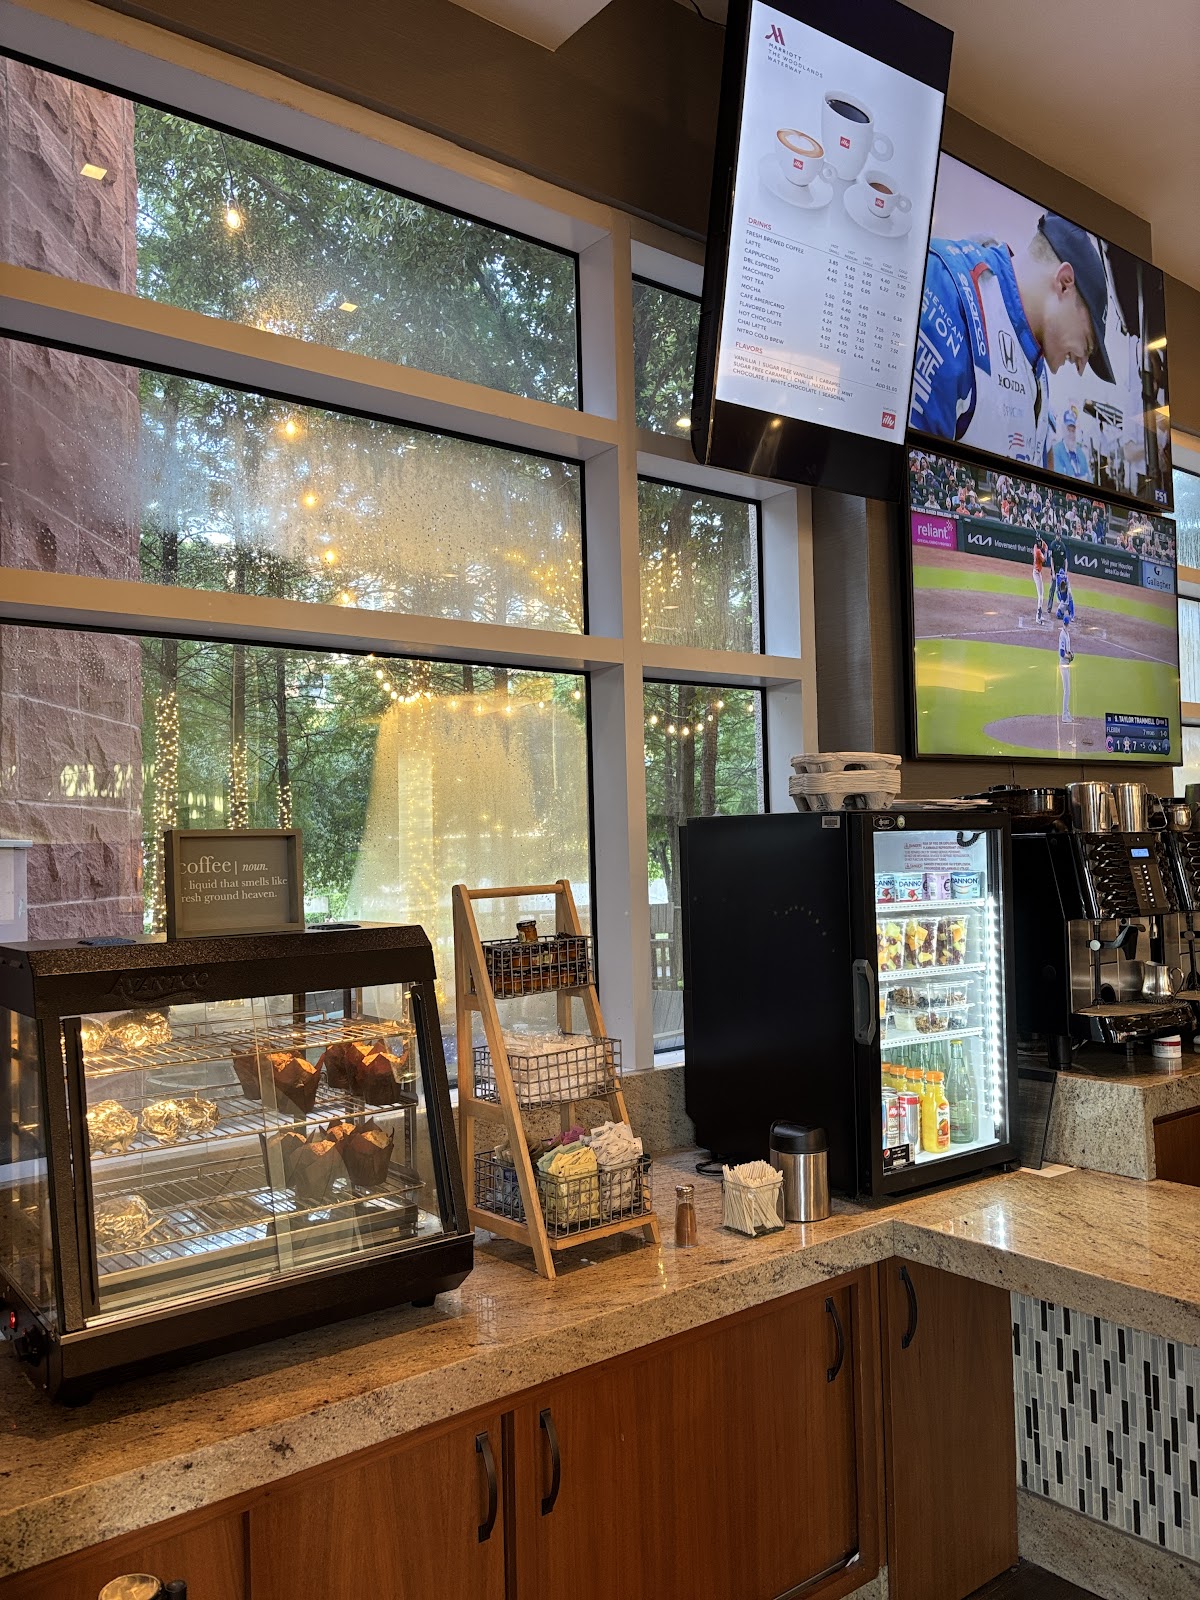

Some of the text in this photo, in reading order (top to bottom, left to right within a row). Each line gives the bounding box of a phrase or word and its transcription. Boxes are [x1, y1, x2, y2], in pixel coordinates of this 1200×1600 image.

[768, 43, 802, 61] MARRIOTT
[768, 49, 823, 78] THE WOODLANDS
[768, 56, 802, 74] WATERWAY
[748, 217, 772, 231] DRINKS
[745, 238, 761, 249] LATTE
[746, 229, 762, 240] FRESH
[763, 235, 785, 248] BREWED
[786, 243, 804, 255] COFFEE
[744, 247, 779, 264] CAPPUCCINO
[743, 265, 774, 280] MACCHIATO
[755, 260, 781, 274] ESPRESSO
[742, 274, 754, 283] HOT
[754, 278, 765, 286] TEA
[741, 283, 761, 294] MOCHA
[739, 300, 766, 313] FLAVORED
[766, 309, 782, 318] LATTE
[754, 296, 785, 310] AMERICANO
[738, 309, 750, 318] HOT
[751, 313, 782, 327] CHOCOLATE
[925, 288, 964, 342] MERICAN
[738, 318, 751, 326] CHAI
[751, 322, 767, 331] LATTE
[737, 326, 753, 336] NITRO
[754, 332, 769, 341] COLD
[770, 336, 784, 345] BREW
[736, 341, 763, 354] FLAVORS
[762, 362, 779, 371] SUGAR
[780, 367, 792, 375] FREE
[734, 360, 751, 370] SUGAR
[752, 366, 764, 374] FREE
[765, 369, 789, 380] CARAMEL
[794, 377, 807, 385] CHAI
[811, 382, 836, 394] HAZELNUT
[733, 368, 846, 403] CHOCOLATE WHITE CHOCOLATE SEASONAL
[998, 374, 1026, 395] HONDA
[883, 414, 895, 427] illy
[1154, 490, 1168, 504] FS1
[917, 523, 950, 540] reliant
[994, 540, 1017, 550] Movement
[1146, 576, 1171, 590] Gallagher
[1119, 716, 1134, 724] TAYLOR
[1132, 740, 1137, 750] 7
[242, 864, 268, 872] noun.
[189, 876, 288, 892] liquid that smells like
[181, 890, 278, 904] resh ground heaven.
